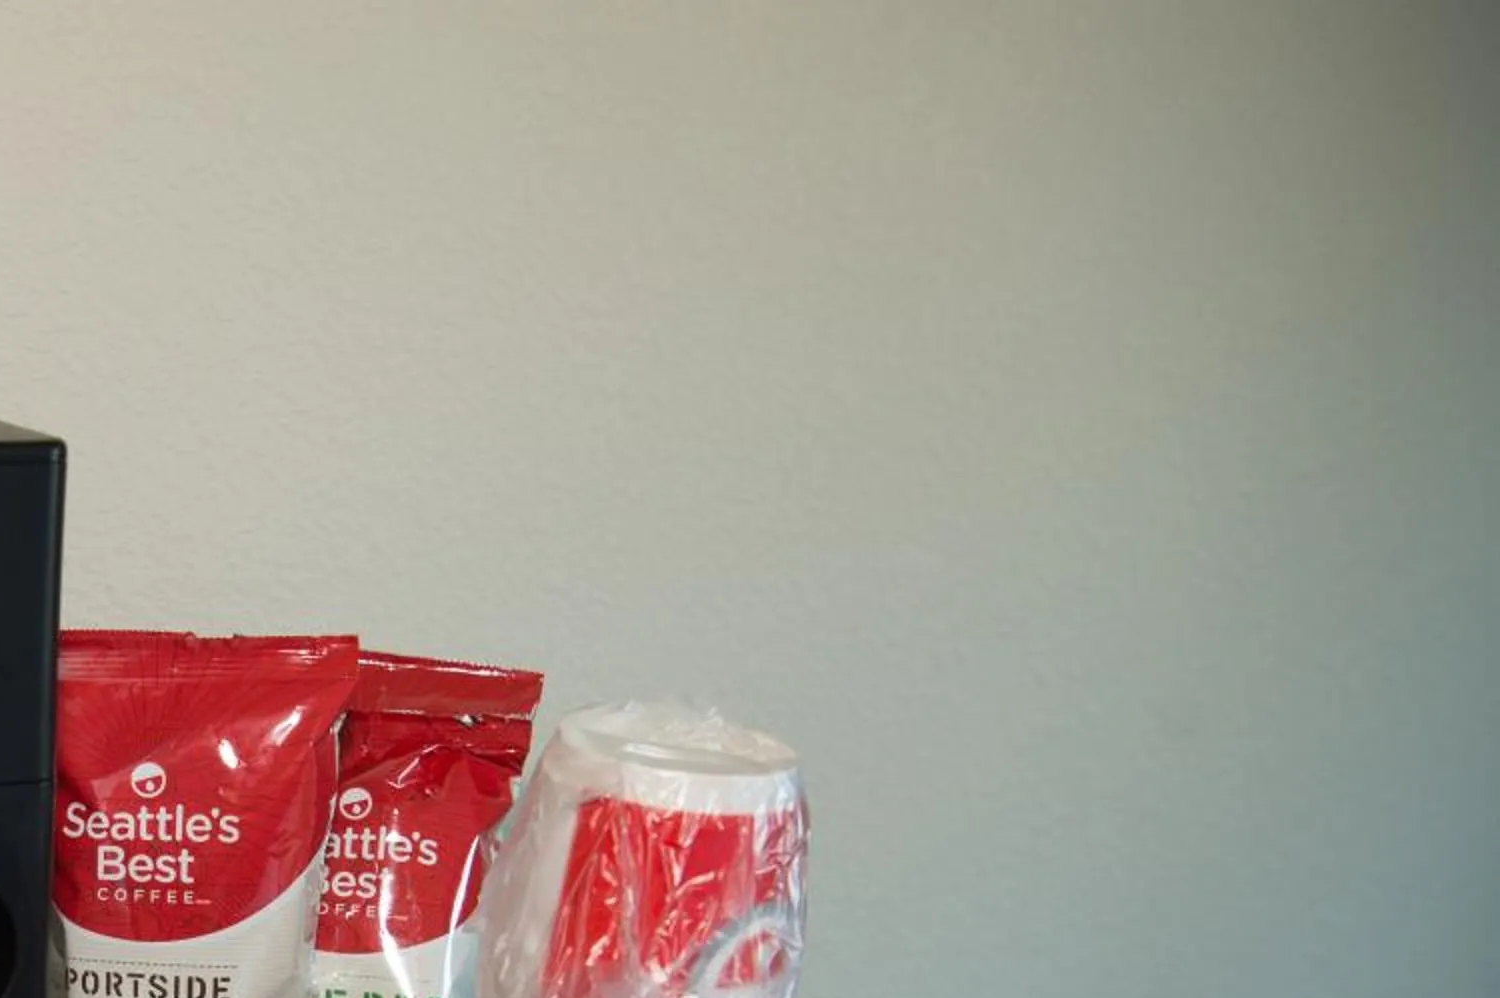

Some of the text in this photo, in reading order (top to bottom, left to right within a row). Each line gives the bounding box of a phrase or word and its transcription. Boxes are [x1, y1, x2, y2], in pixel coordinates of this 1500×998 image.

[62, 801, 241, 844] Seattle's
[96, 844, 195, 884] Best
[325, 825, 439, 865] attle's
[97, 886, 195, 905] COFFEE
